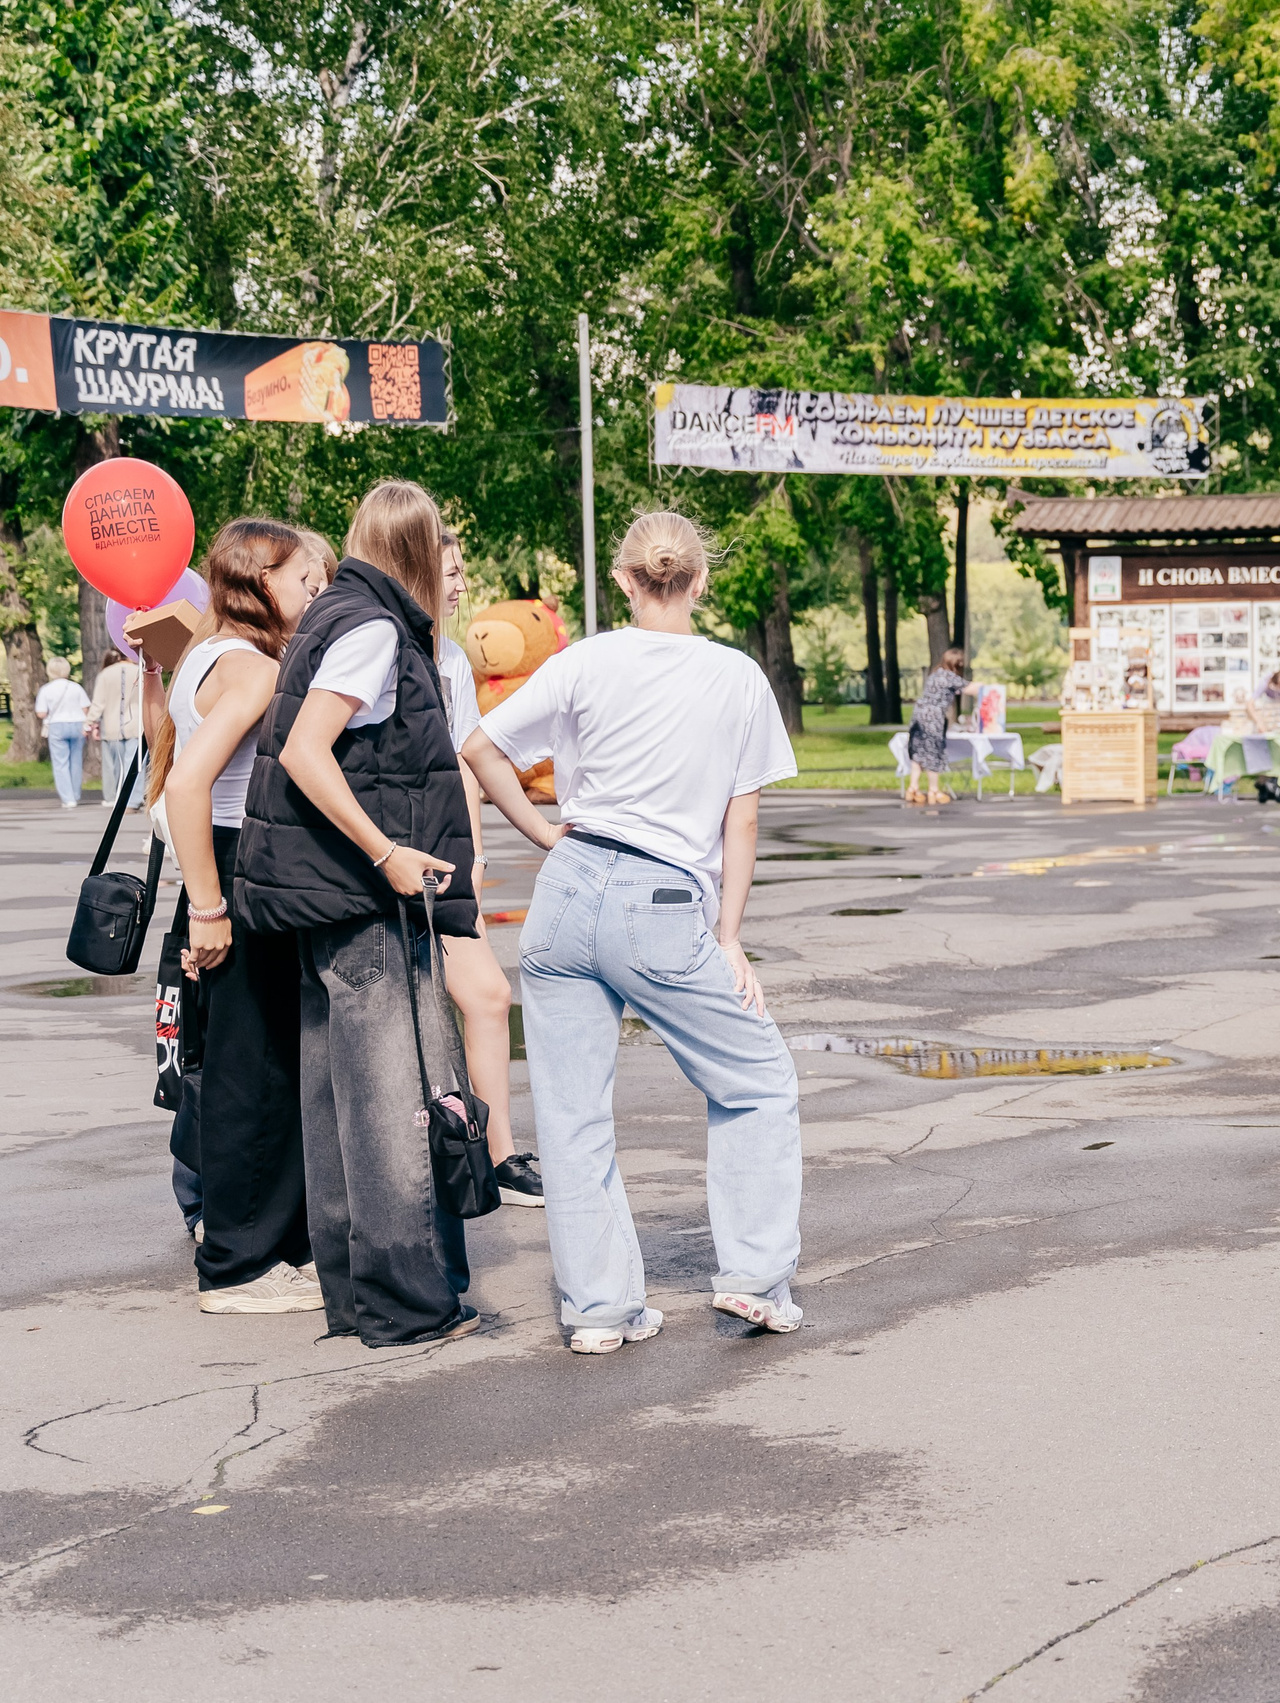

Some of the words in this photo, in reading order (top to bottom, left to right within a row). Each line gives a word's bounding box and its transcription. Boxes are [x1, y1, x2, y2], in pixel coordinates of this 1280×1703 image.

[74, 327, 197, 372] КРУТАЯ
[74, 367, 225, 410] ШАУРМА!
[801, 401, 927, 425] СОБИРАЕМ
[932, 404, 1026, 427] ЛУЧШЕЕ
[1032, 409, 1135, 428] ДЕТСКОЕ
[832, 422, 983, 448] КОМЬЮНИТИ
[989, 428, 1110, 450] КУЗБАССА
[84, 488, 155, 509] СПАСАЕМ
[89, 502, 155, 526] ДАНИЛА
[91, 518, 160, 540] ВМЕСТЕ
[95, 533, 161, 550] #ДАНИЛЖИВИ
[1138, 568, 1154, 586] И
[1156, 567, 1224, 586] СНОВА
